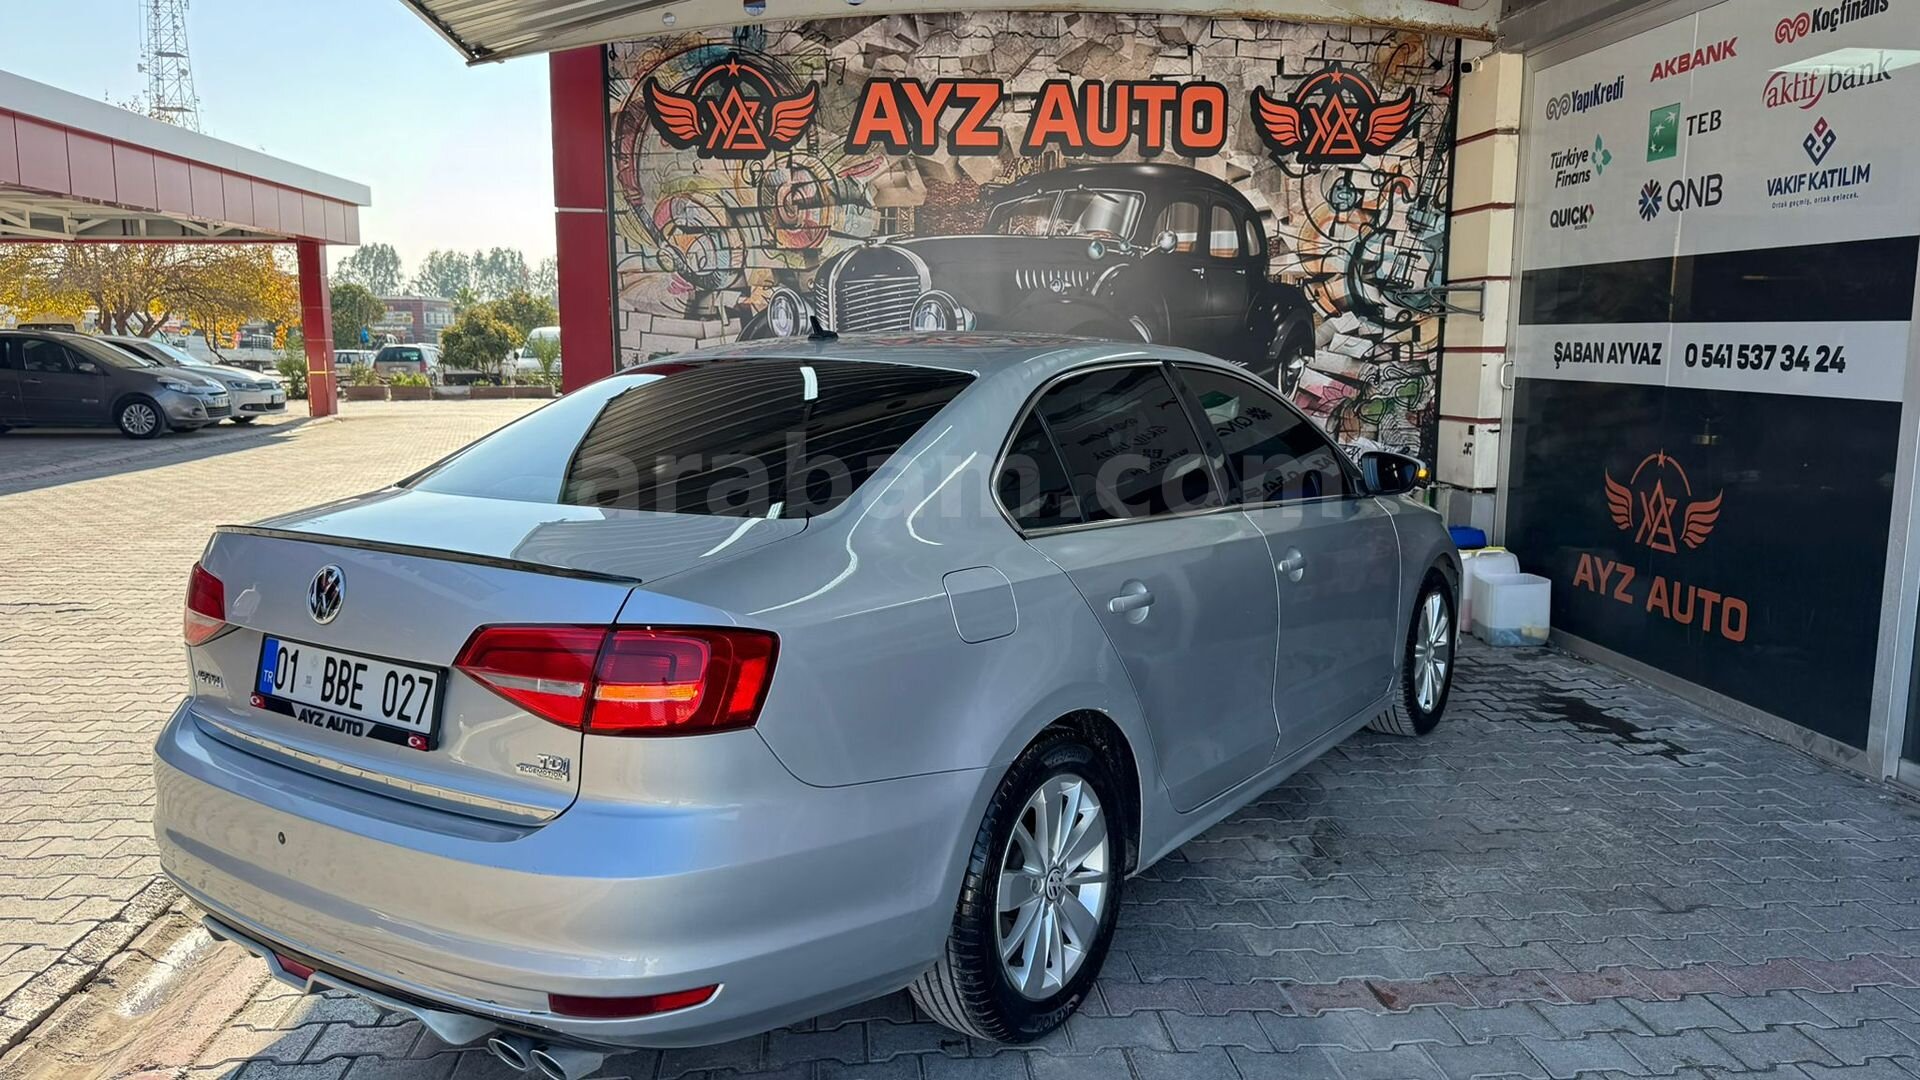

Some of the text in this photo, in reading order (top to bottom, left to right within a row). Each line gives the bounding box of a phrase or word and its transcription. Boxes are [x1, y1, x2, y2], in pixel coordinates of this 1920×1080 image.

[1811, 0, 1889, 33] Koçfinans
[1650, 36, 1738, 82] AKBANK
[1766, 51, 1893, 108] aktif bank
[852, 82, 1225, 148] AYZ AUTO
[1686, 109, 1722, 136] TEB
[1550, 147, 1589, 170] Türkiye
[1555, 169, 1591, 188] Finans
[1667, 173, 1724, 212] QNB
[1767, 163, 1871, 197] VAKIF KATILIM
[1550, 204, 1589, 228] QUICK
[1554, 341, 1662, 369] ŞABAN AYVAZ
[1685, 343, 1846, 373] 0 541 537 34 24
[1573, 553, 1748, 642] AYZ AUTO
[264, 646, 434, 725] TR 01 BBE 027
[298, 708, 364, 737] AYZ AUTO
[536, 752, 570, 773] TDI
